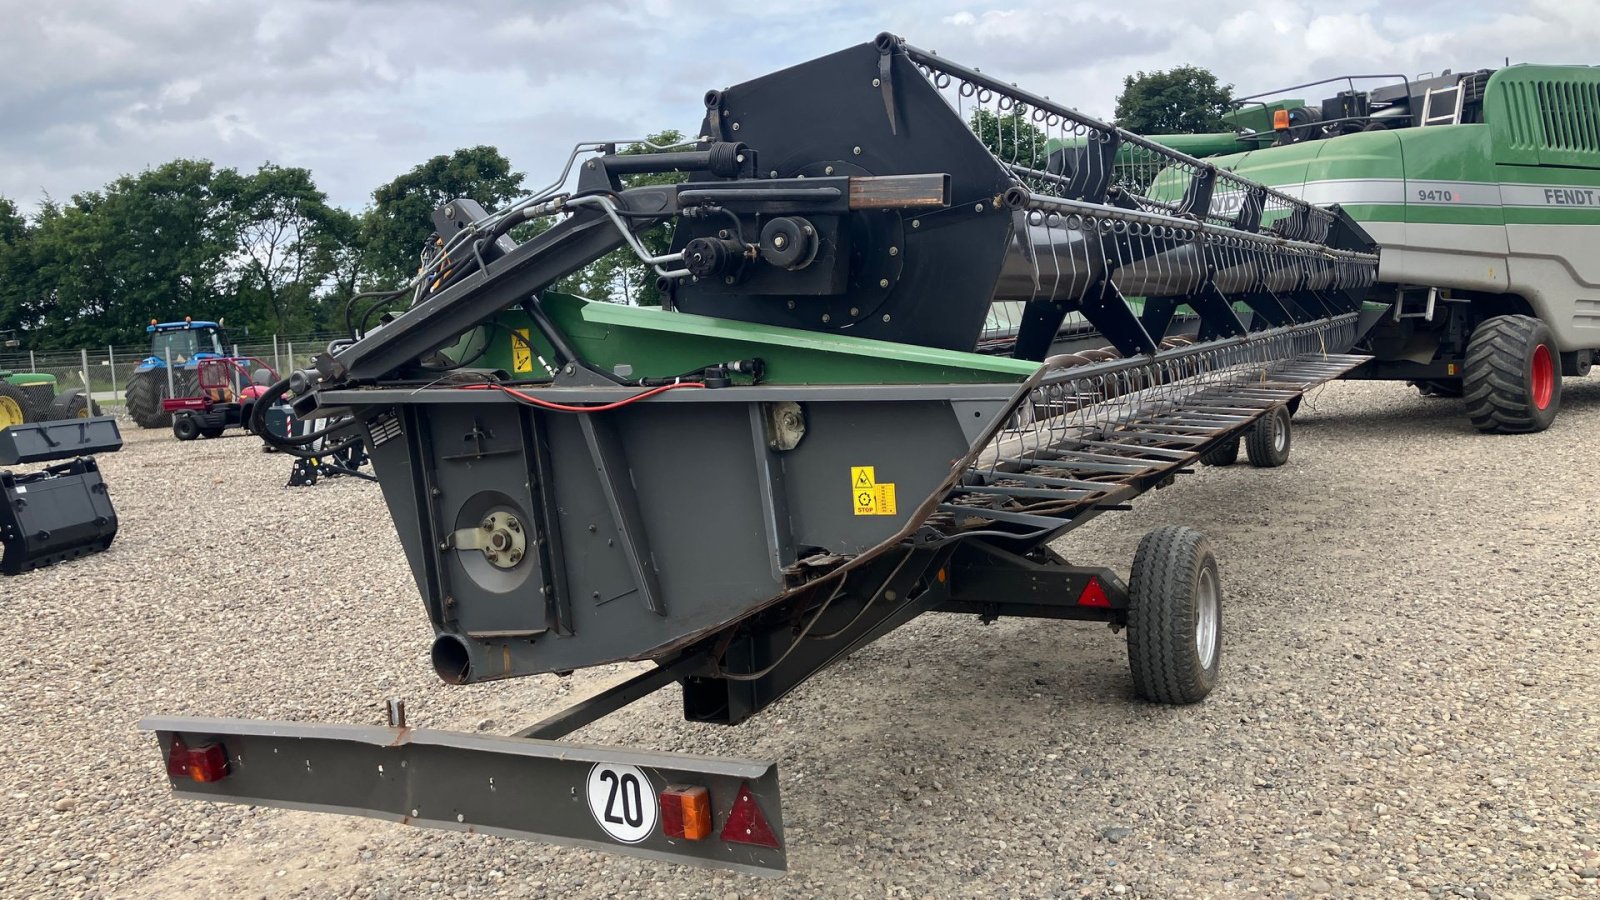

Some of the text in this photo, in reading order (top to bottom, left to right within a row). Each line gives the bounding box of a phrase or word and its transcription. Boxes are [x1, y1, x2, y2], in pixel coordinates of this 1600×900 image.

[1418, 190, 1452, 202] 9470
[1543, 188, 1593, 206] FENDT
[599, 769, 643, 828] 20
